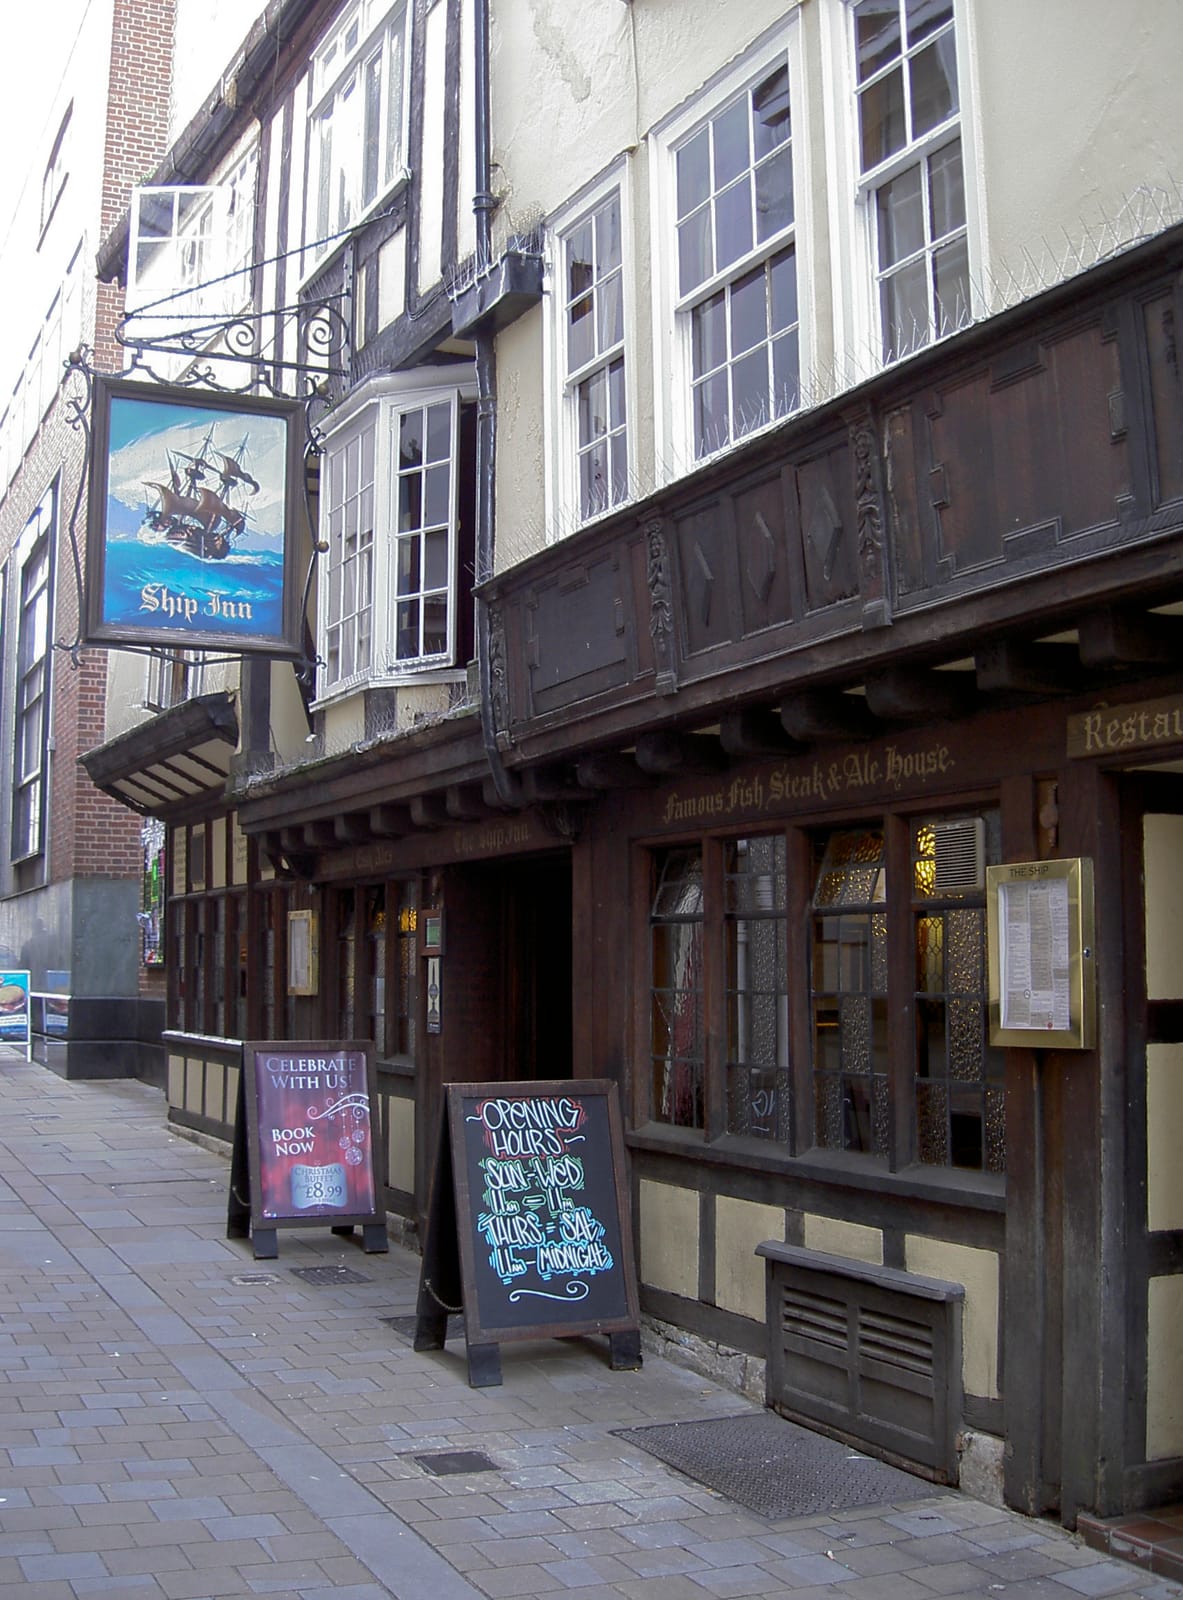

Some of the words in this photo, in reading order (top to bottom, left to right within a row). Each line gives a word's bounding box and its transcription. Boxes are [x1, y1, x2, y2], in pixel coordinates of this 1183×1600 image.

[139, 582, 198, 623] Ship
[204, 591, 253, 620] Inn
[662, 792, 723, 824] Famous
[725, 776, 763, 813] Fish
[766, 762, 827, 809] Steak
[828, 762, 842, 791] &
[843, 748, 878, 789] Ale
[884, 743, 955, 790] House
[1009, 867, 1026, 877] THE
[1028, 865, 1049, 876] SHIP
[266, 1058, 356, 1072] CELEBRATE
[272, 1075, 320, 1089] WITH
[272, 1126, 316, 1142] BOOK
[492, 1128, 562, 1156] HOURS
[275, 1141, 315, 1157] NOW
[306, 1182, 342, 1198] £8.99
[482, 1215, 543, 1246] THURS
